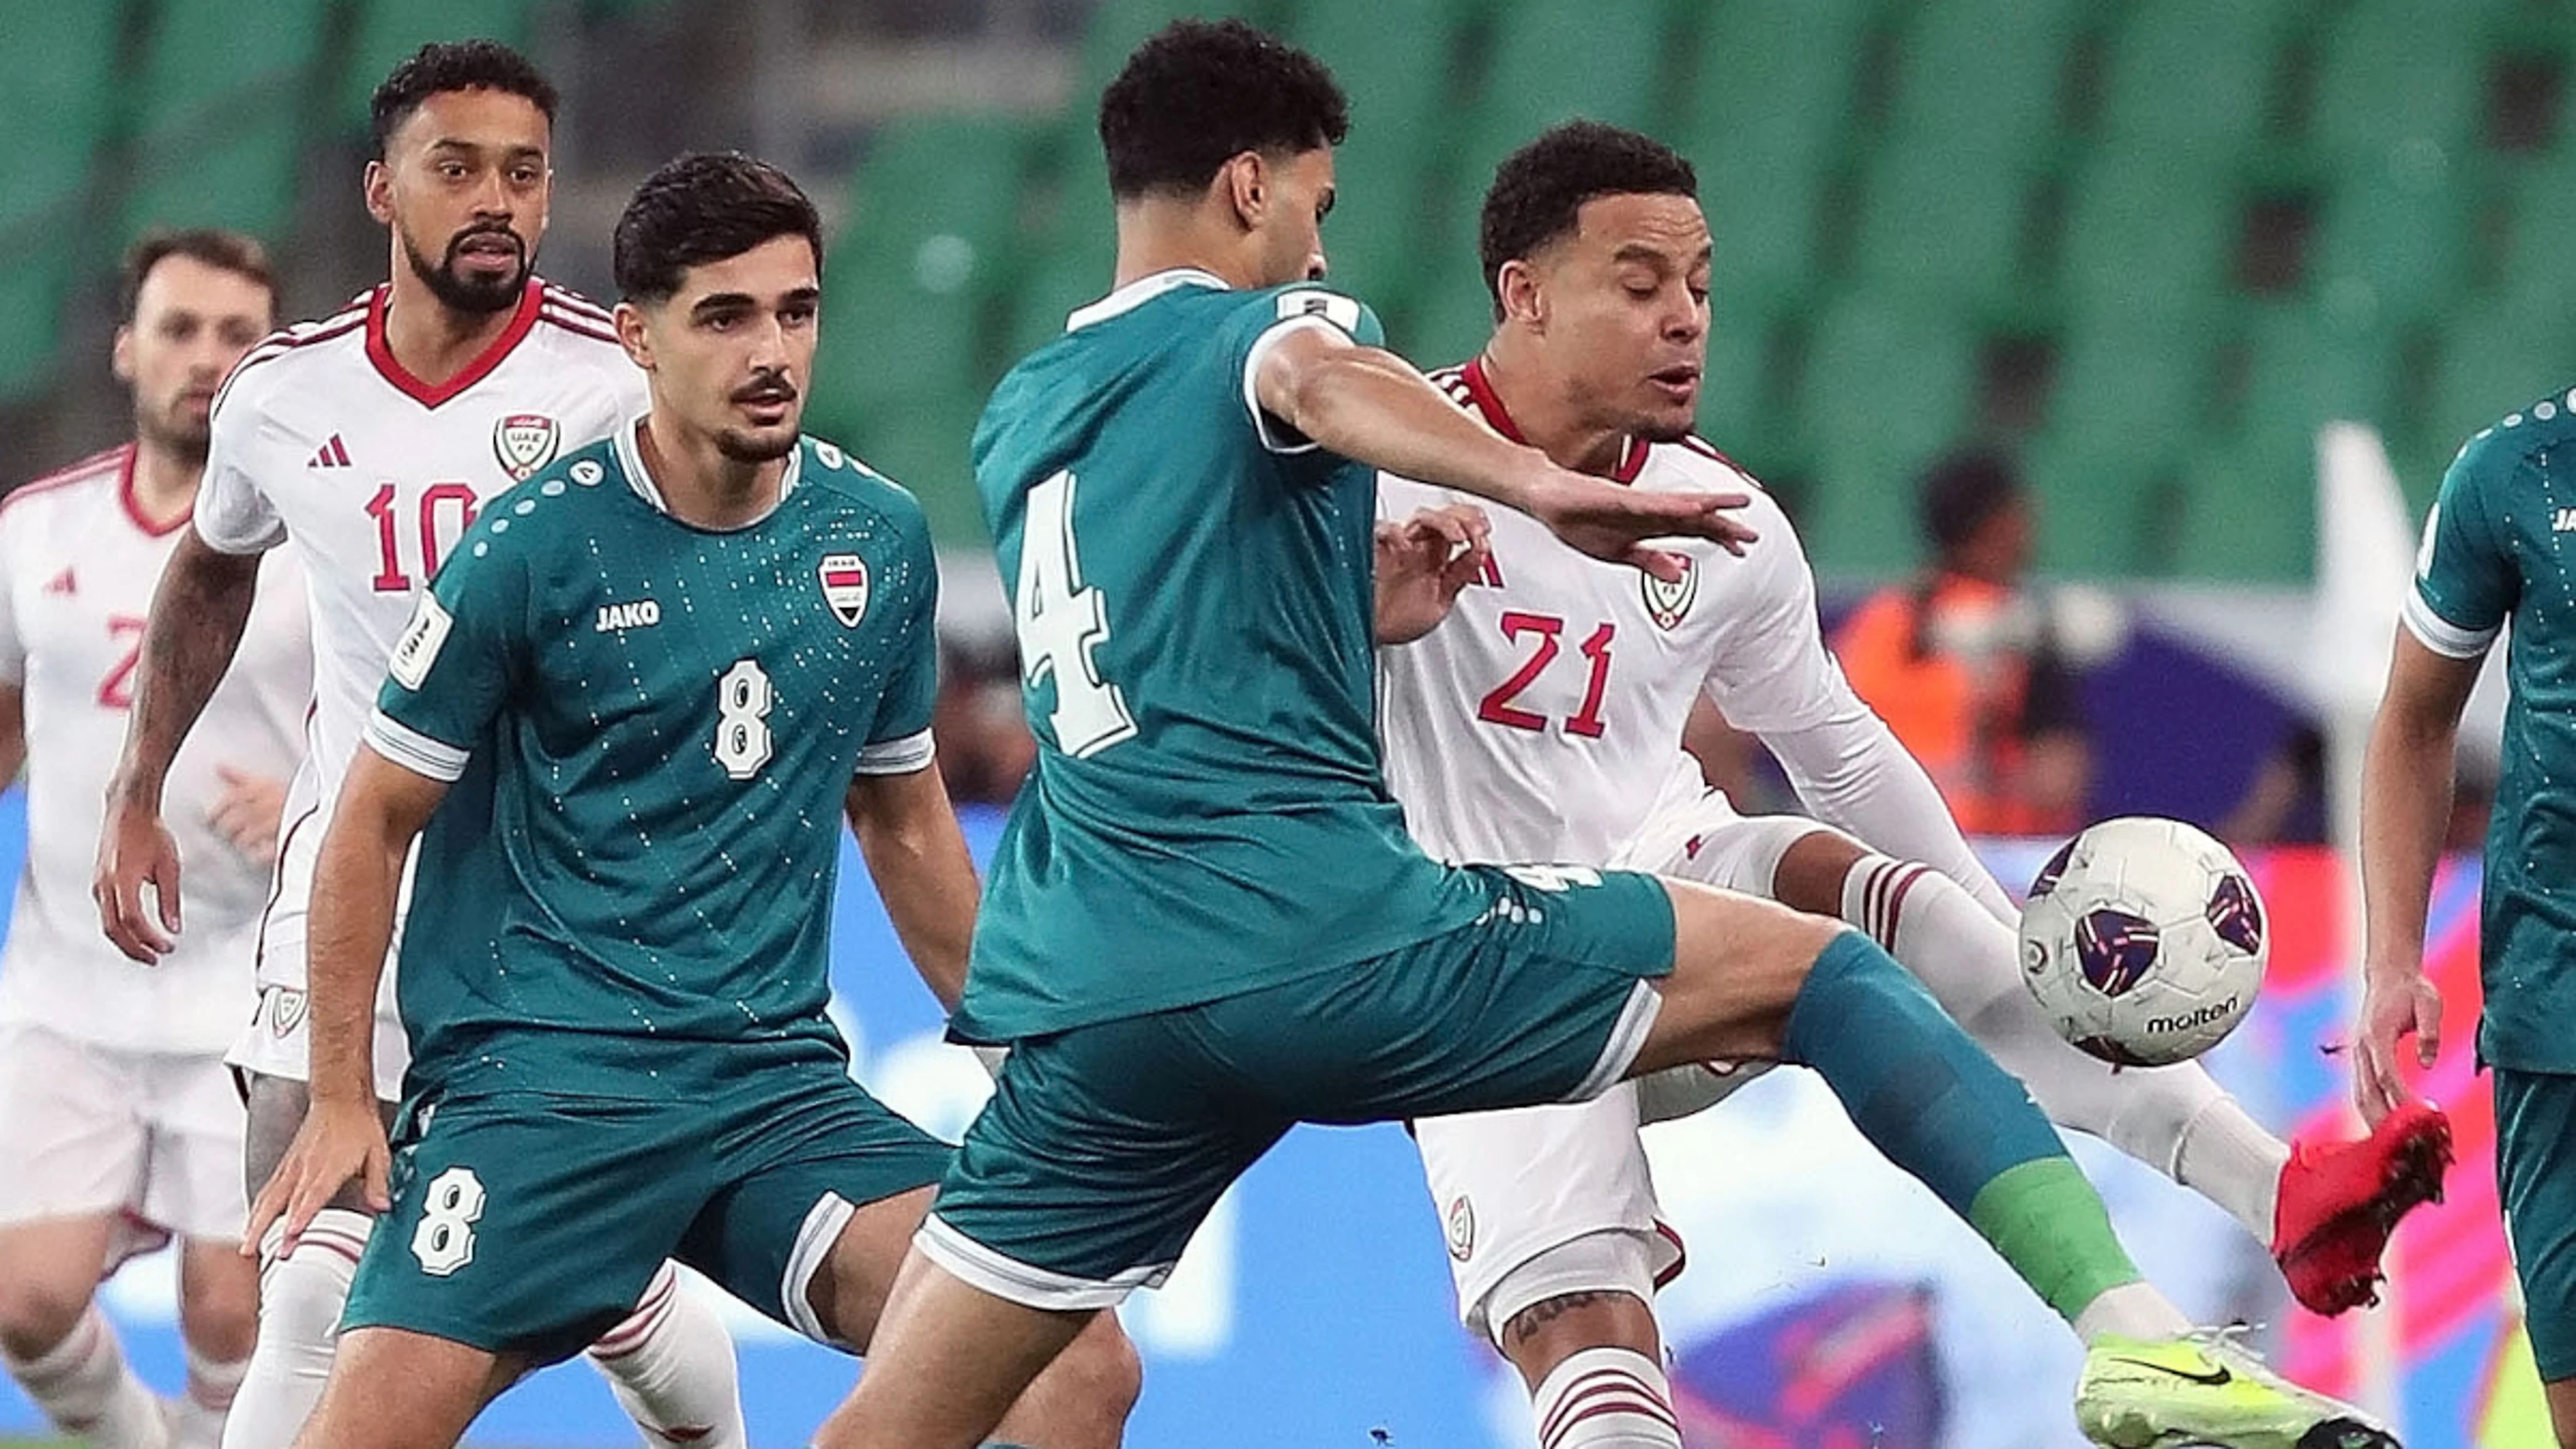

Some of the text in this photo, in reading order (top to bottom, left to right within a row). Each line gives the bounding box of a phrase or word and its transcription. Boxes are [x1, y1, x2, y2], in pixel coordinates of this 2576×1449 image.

[364, 483, 478, 592] 10
[596, 600, 660, 632] JAKO
[1016, 469, 1138, 759] 4
[714, 659, 772, 779] 8
[1479, 611, 1615, 739] 21
[2147, 996, 2239, 1033] molten
[410, 1166, 486, 1276] 8
